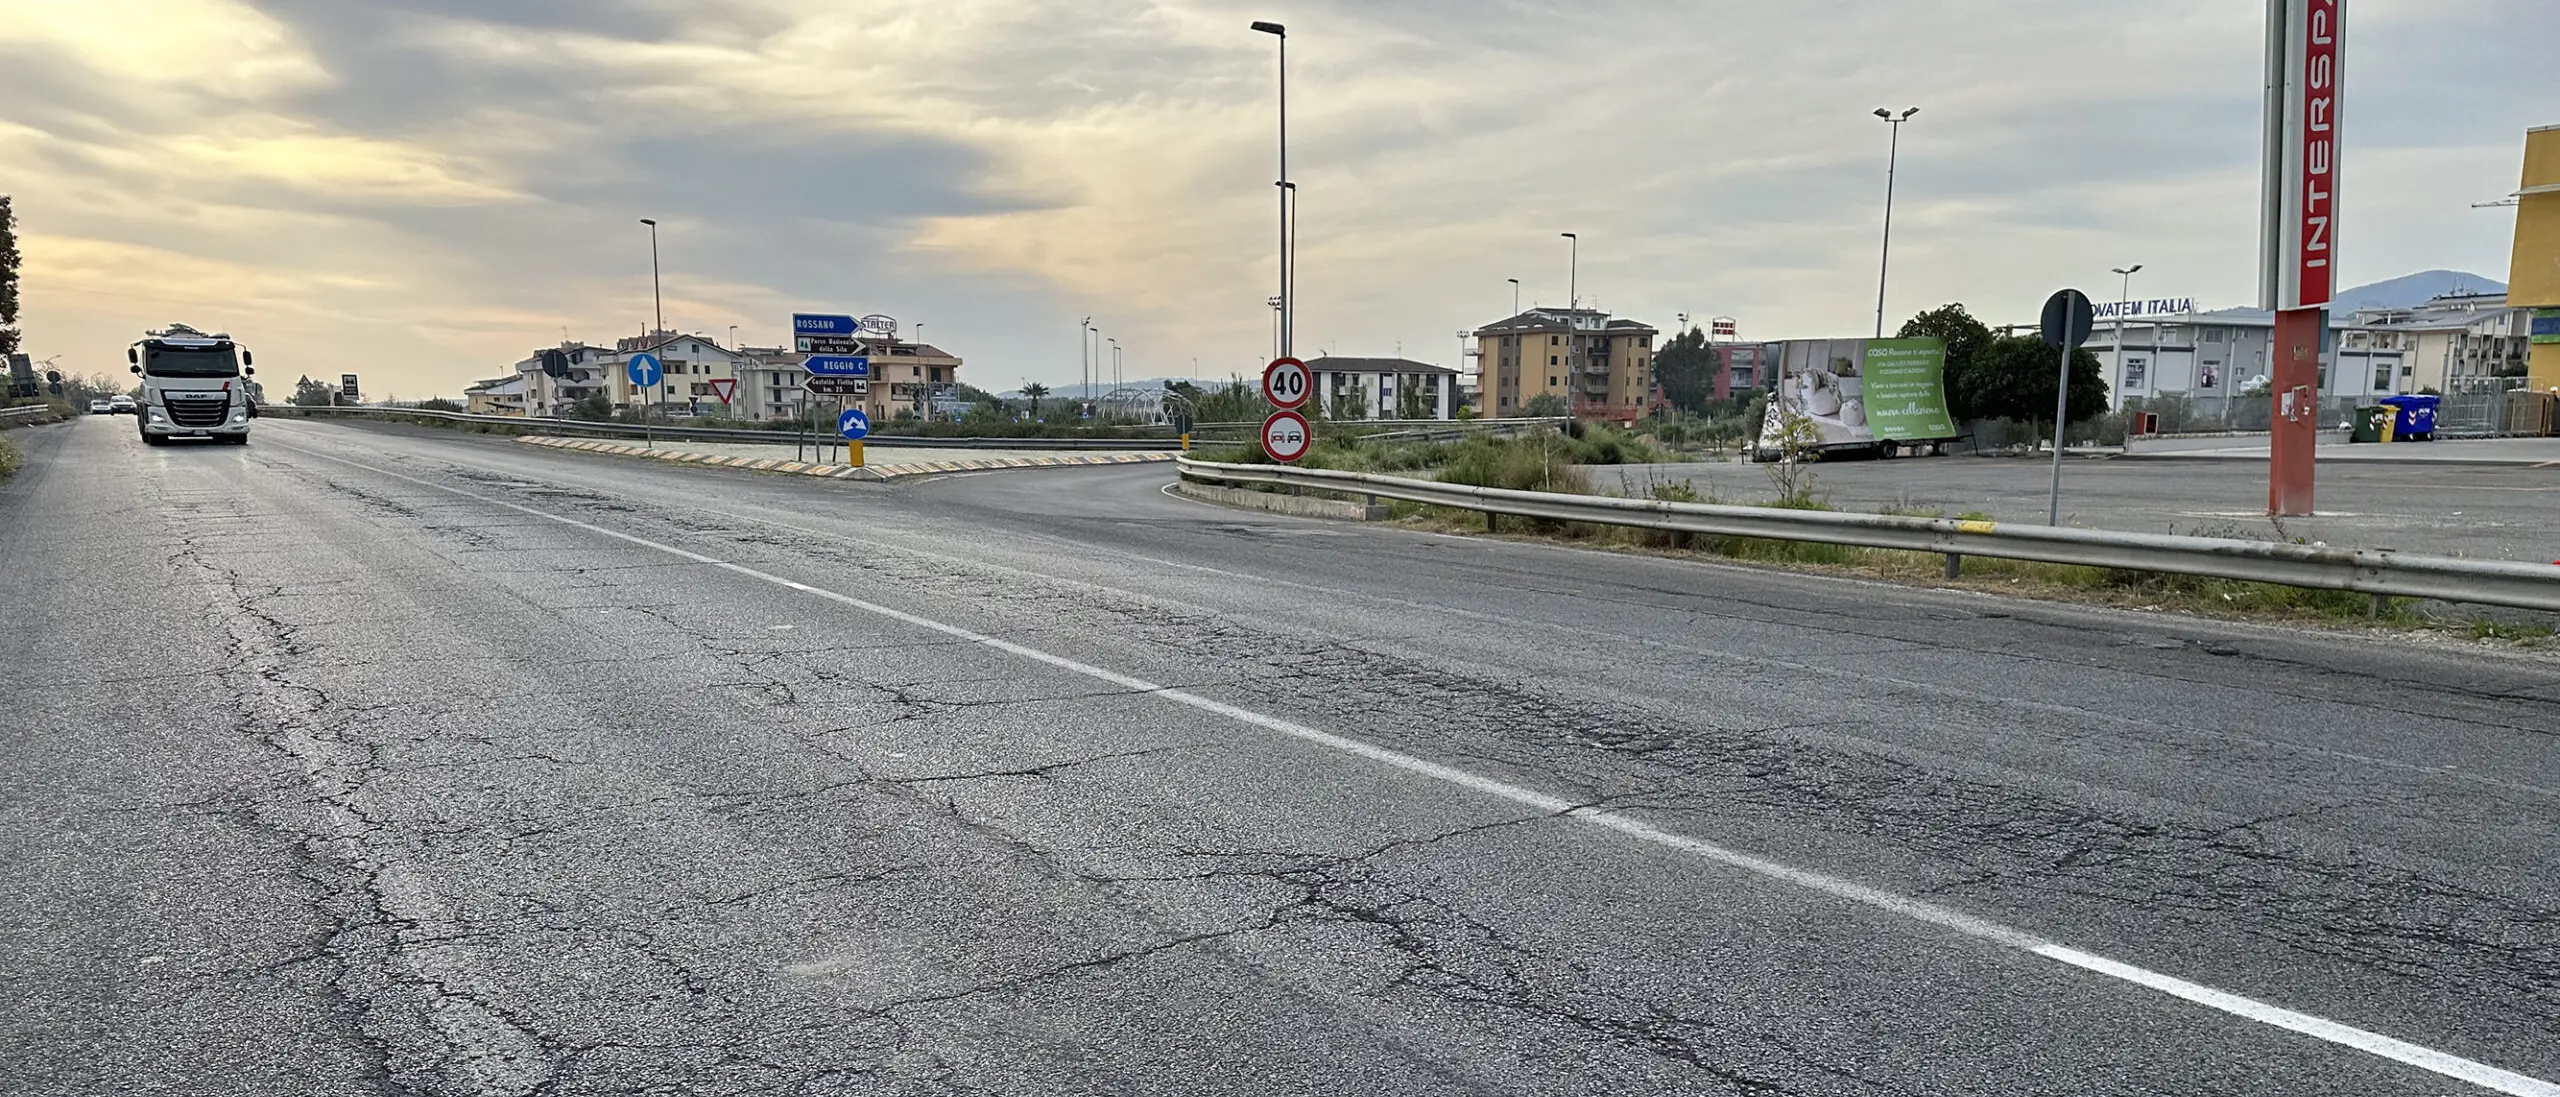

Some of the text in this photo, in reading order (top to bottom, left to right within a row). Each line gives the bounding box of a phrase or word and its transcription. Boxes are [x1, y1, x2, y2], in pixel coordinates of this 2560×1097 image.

[2306, 0, 2332, 267] INTERSP
[2148, 298, 2192, 314] ITALIA
[796, 320, 834, 329] ROSSANO
[828, 337, 855, 345] Nazionale
[819, 345, 848, 353] della Sila
[823, 361, 866, 371] REGGIO C.
[811, 378, 835, 386] Castello
[1273, 371, 1303, 395] 40
